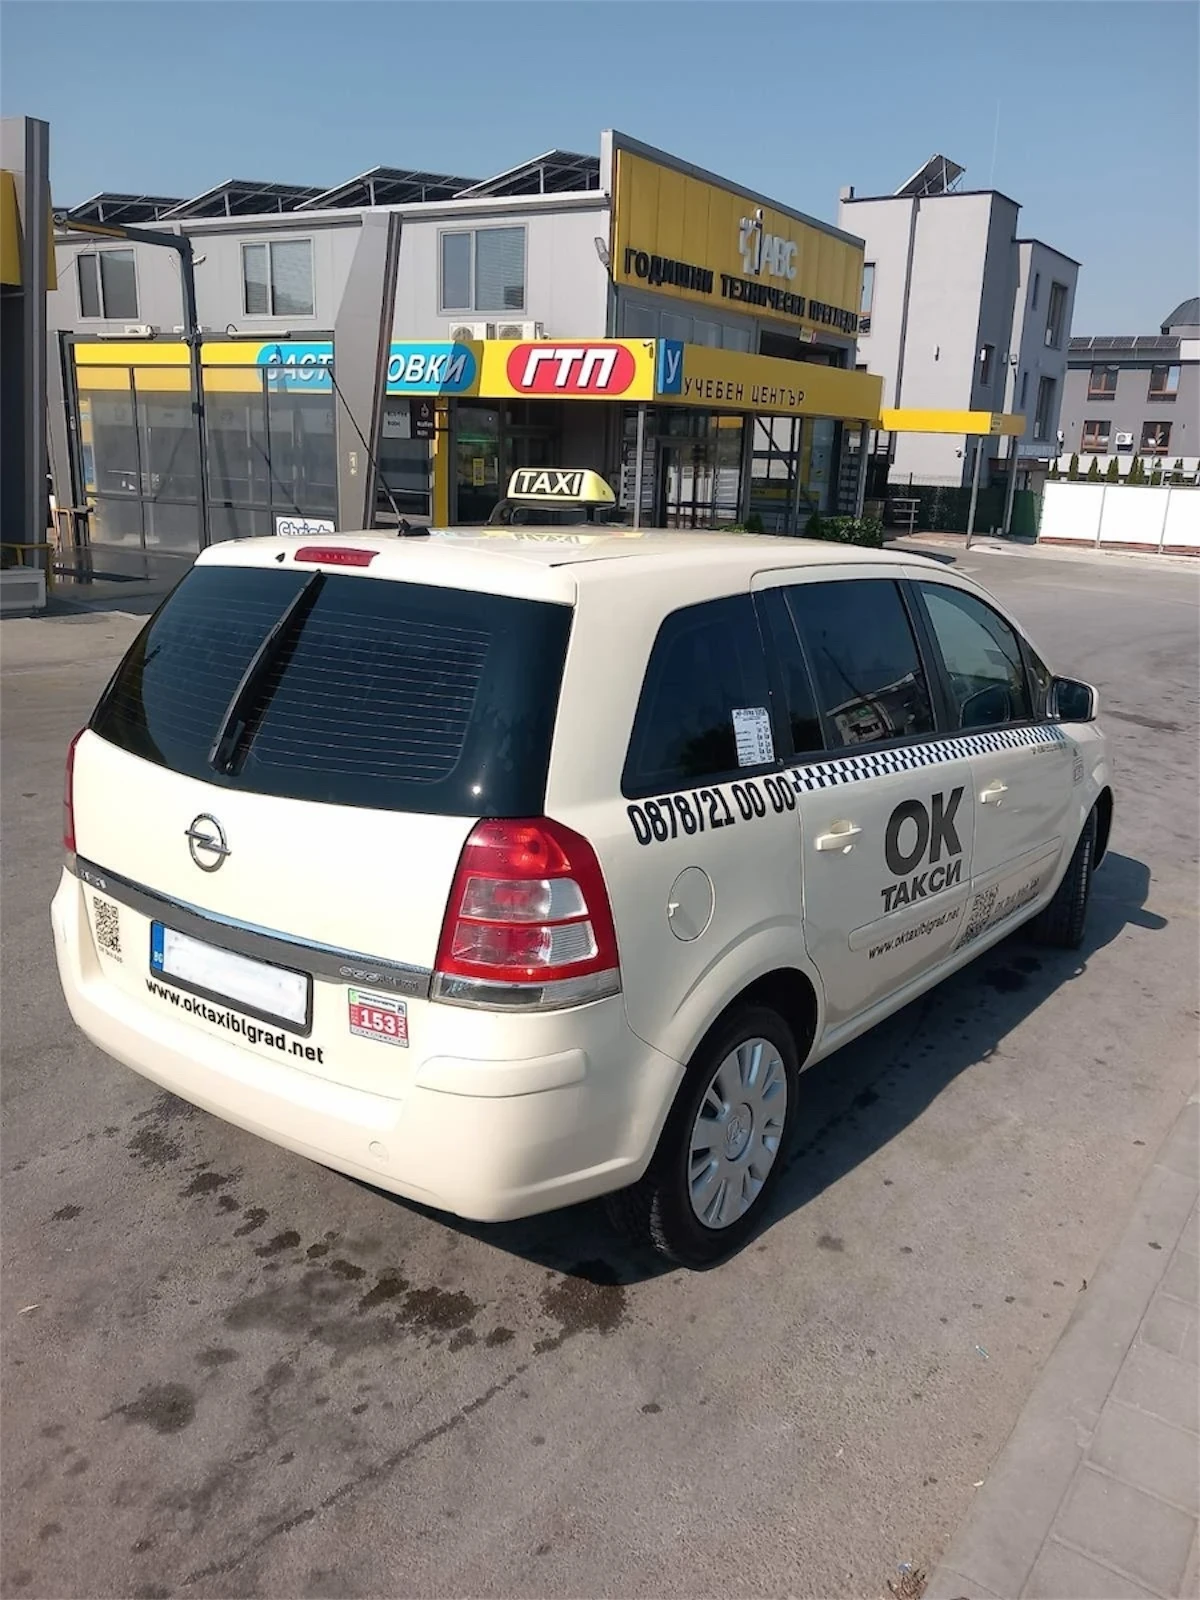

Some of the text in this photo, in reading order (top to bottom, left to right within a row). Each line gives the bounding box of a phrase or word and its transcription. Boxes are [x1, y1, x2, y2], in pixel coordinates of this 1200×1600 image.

[624, 247, 714, 294] ГОДИШНИ
[720, 273, 806, 318] ТЕХНИЧЕСКИ
[521, 347, 619, 388] ГТП
[684, 376, 805, 407] УЧЕБЕН ЦЕНТЪР
[518, 471, 583, 496] TAXI
[626, 775, 797, 846] 0878/21 00 00
[880, 859, 962, 913] ТАКСИ
[145, 978, 324, 1064] www.oktaxiblgrad.net
[360, 1009, 396, 1034] 153
